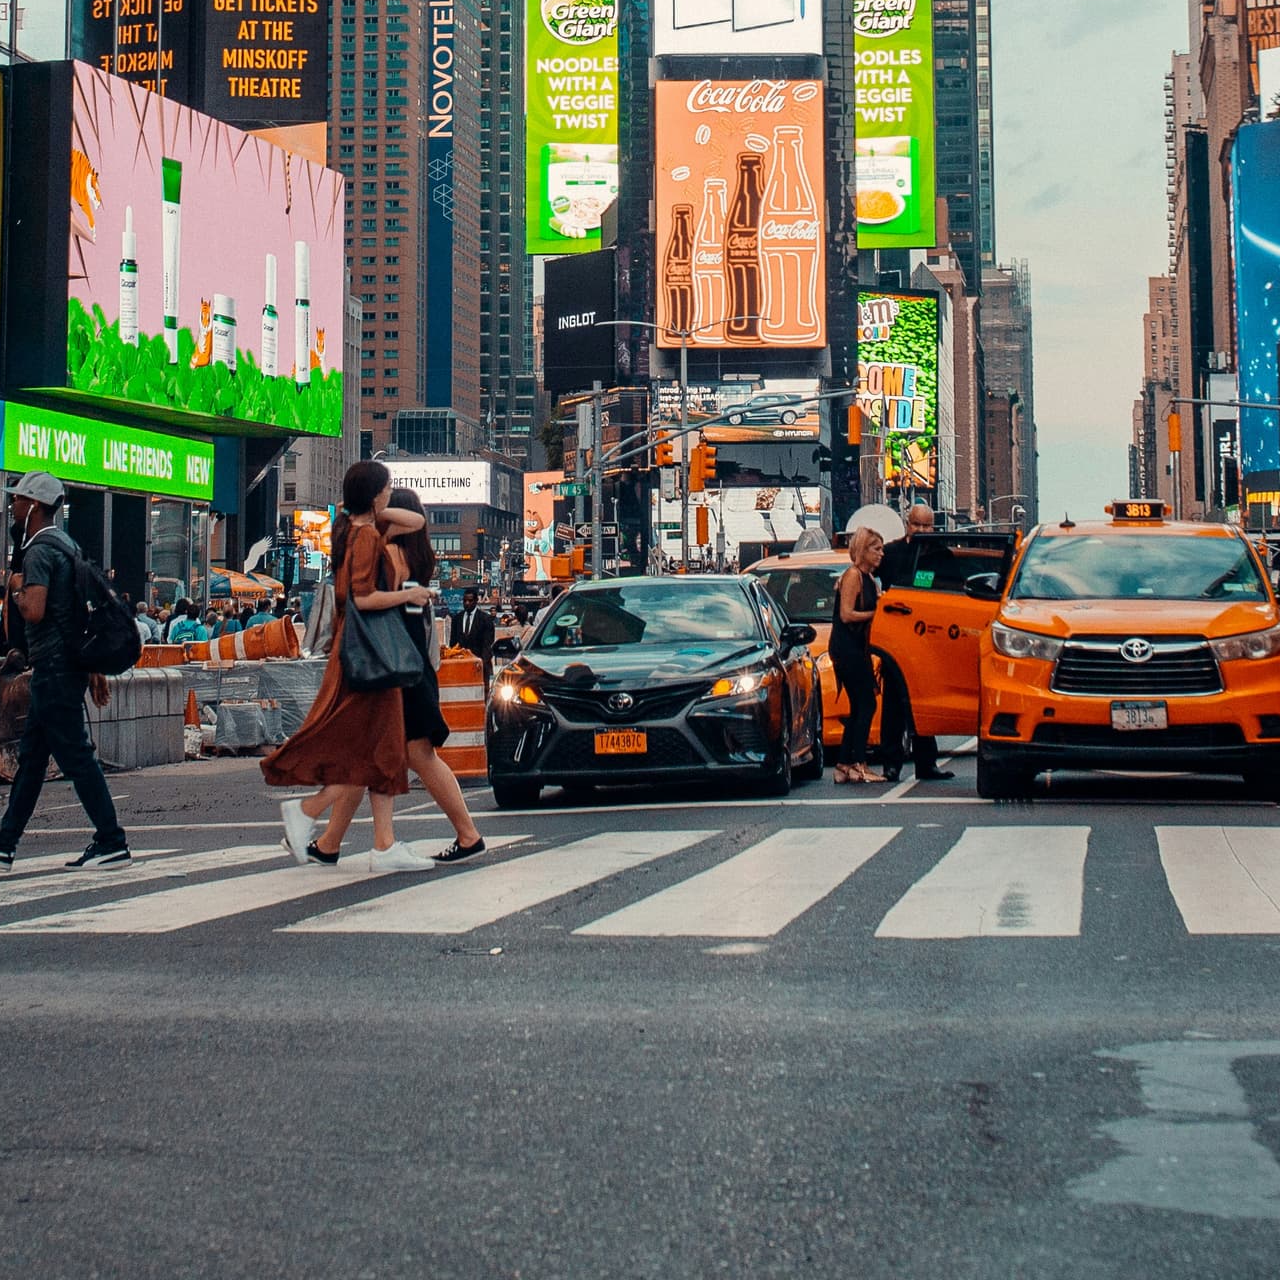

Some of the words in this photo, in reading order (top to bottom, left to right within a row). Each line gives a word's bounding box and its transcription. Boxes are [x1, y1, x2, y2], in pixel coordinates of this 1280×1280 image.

[551, 4, 615, 20] Green
[238, 20, 261, 41] AT
[263, 21, 294, 41] THE
[558, 19, 617, 38] Giant
[223, 50, 308, 70] MINSKOFF
[855, 49, 922, 66] OODLES
[549, 77, 596, 92] WITH
[600, 77, 613, 91] A
[896, 70, 910, 84] A
[228, 77, 301, 98] THEATRE
[856, 88, 912, 104] EGGIE
[547, 95, 615, 111] VEGGIE
[687, 79, 789, 114] Coca-Cola
[554, 114, 608, 130] TWIST
[762, 220, 820, 240] Coca-Cola
[558, 311, 596, 329] INGLOT
[857, 398, 923, 429] NSIDE
[19, 422, 49, 460] NEW
[52, 430, 87, 466] YORK
[103, 440, 128, 472] LINE
[130, 446, 173, 481] FRIENDS
[186, 454, 210, 486] NEW
[561, 486, 569, 494] W
[573, 486, 581, 494] 45
[1125, 503, 1152, 517] 3B13
